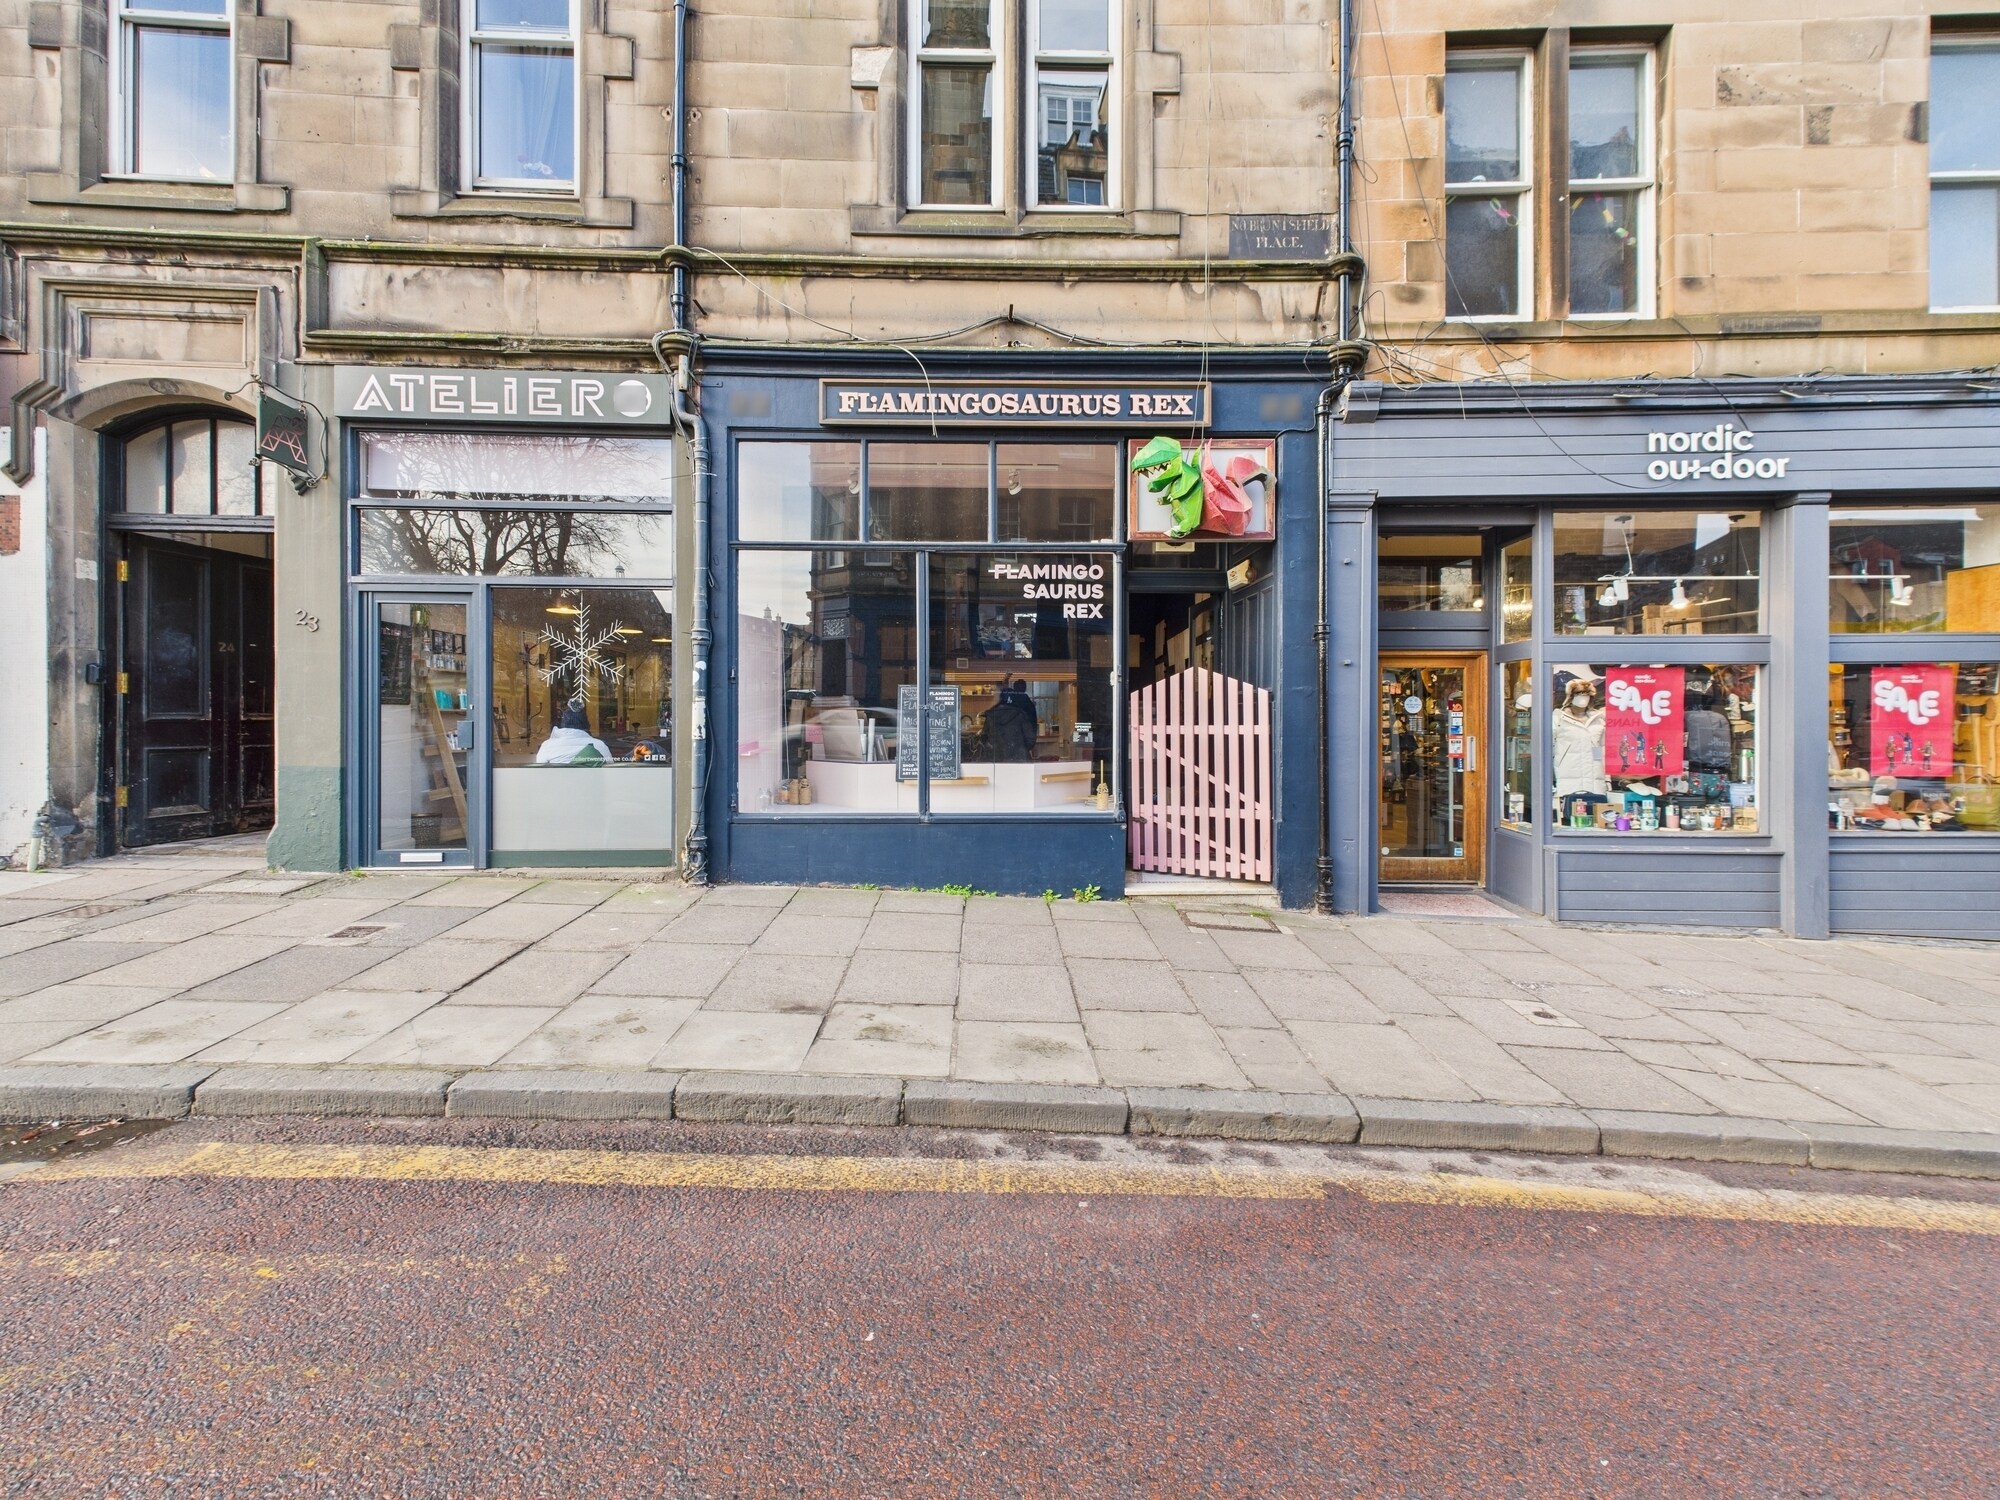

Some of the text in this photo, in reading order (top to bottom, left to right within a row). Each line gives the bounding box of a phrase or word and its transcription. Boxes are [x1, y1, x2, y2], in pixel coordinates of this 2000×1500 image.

[838, 391, 1194, 416] FLAMINGOSAURUS REX
[1648, 423, 1755, 453] nordic
[993, 564, 1104, 580] FLAMINGO
[1023, 583, 1104, 599] SAURUS
[295, 608, 320, 633] 23
[1063, 603, 1104, 619] REX
[218, 641, 236, 653] 24
[1608, 680, 1672, 725] SALE
[1874, 680, 1940, 726] SALE
